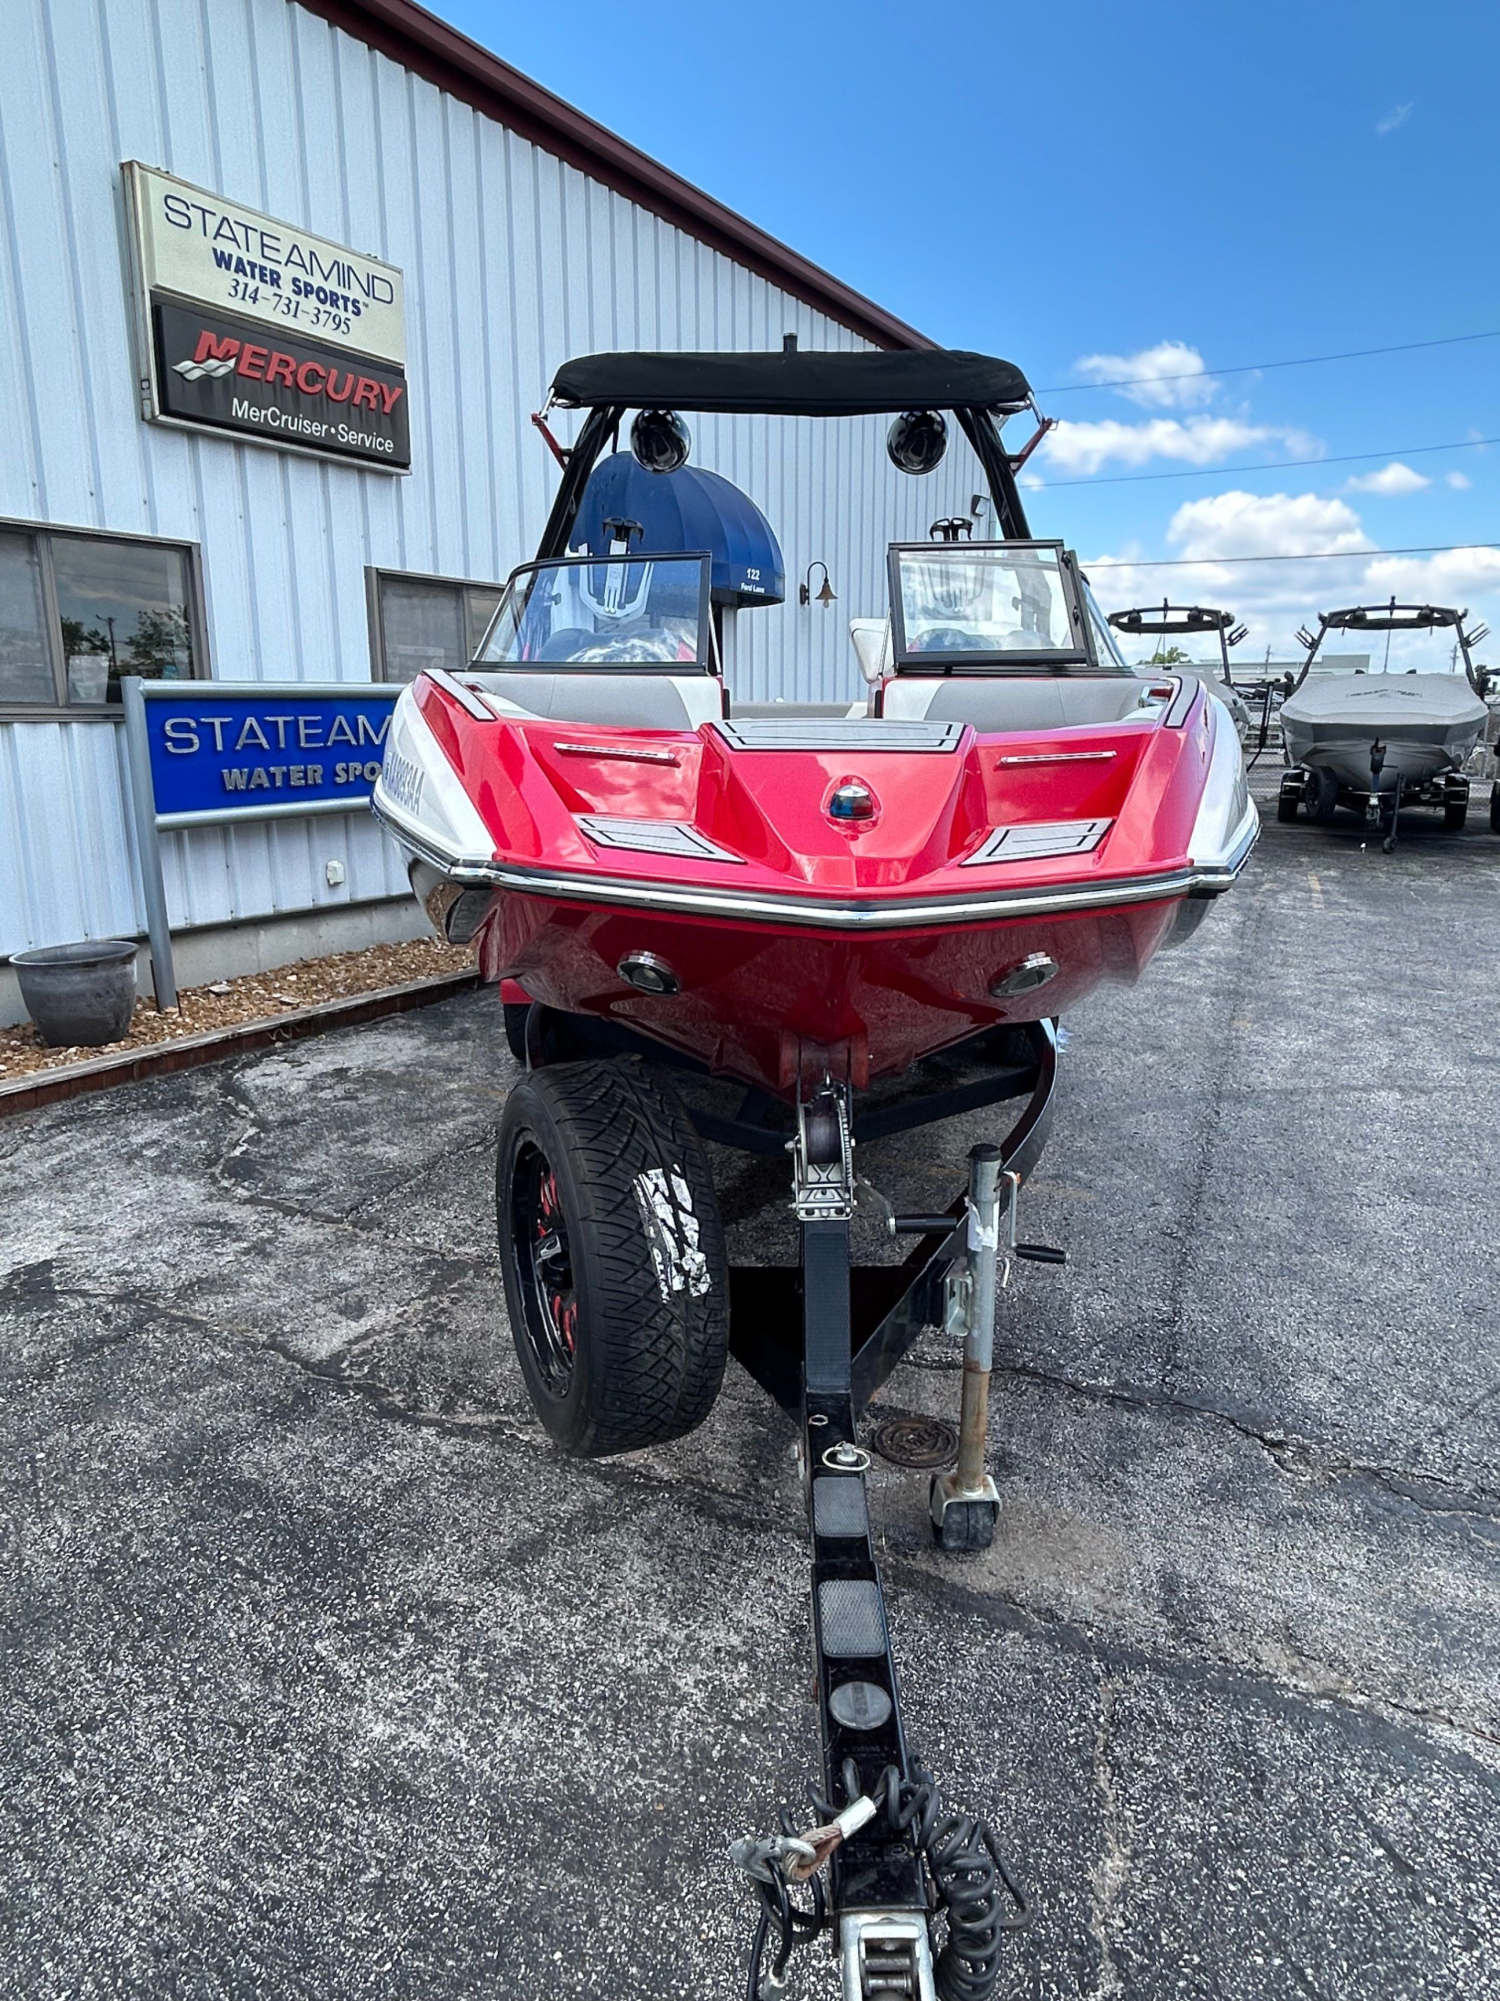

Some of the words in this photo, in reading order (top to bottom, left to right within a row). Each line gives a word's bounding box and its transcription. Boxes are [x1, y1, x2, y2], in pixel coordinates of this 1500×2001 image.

[163, 194, 394, 305] STATEAMIND
[212, 247, 282, 289] WATER
[227, 278, 351, 336] 314-731-3795
[194, 330, 403, 415] MERCURY
[741, 582, 753, 592] Ford
[753, 584, 765, 594] Lane
[746, 568, 760, 581] 122
[222, 764, 324, 791] WATER
[335, 761, 382, 784] SPO
